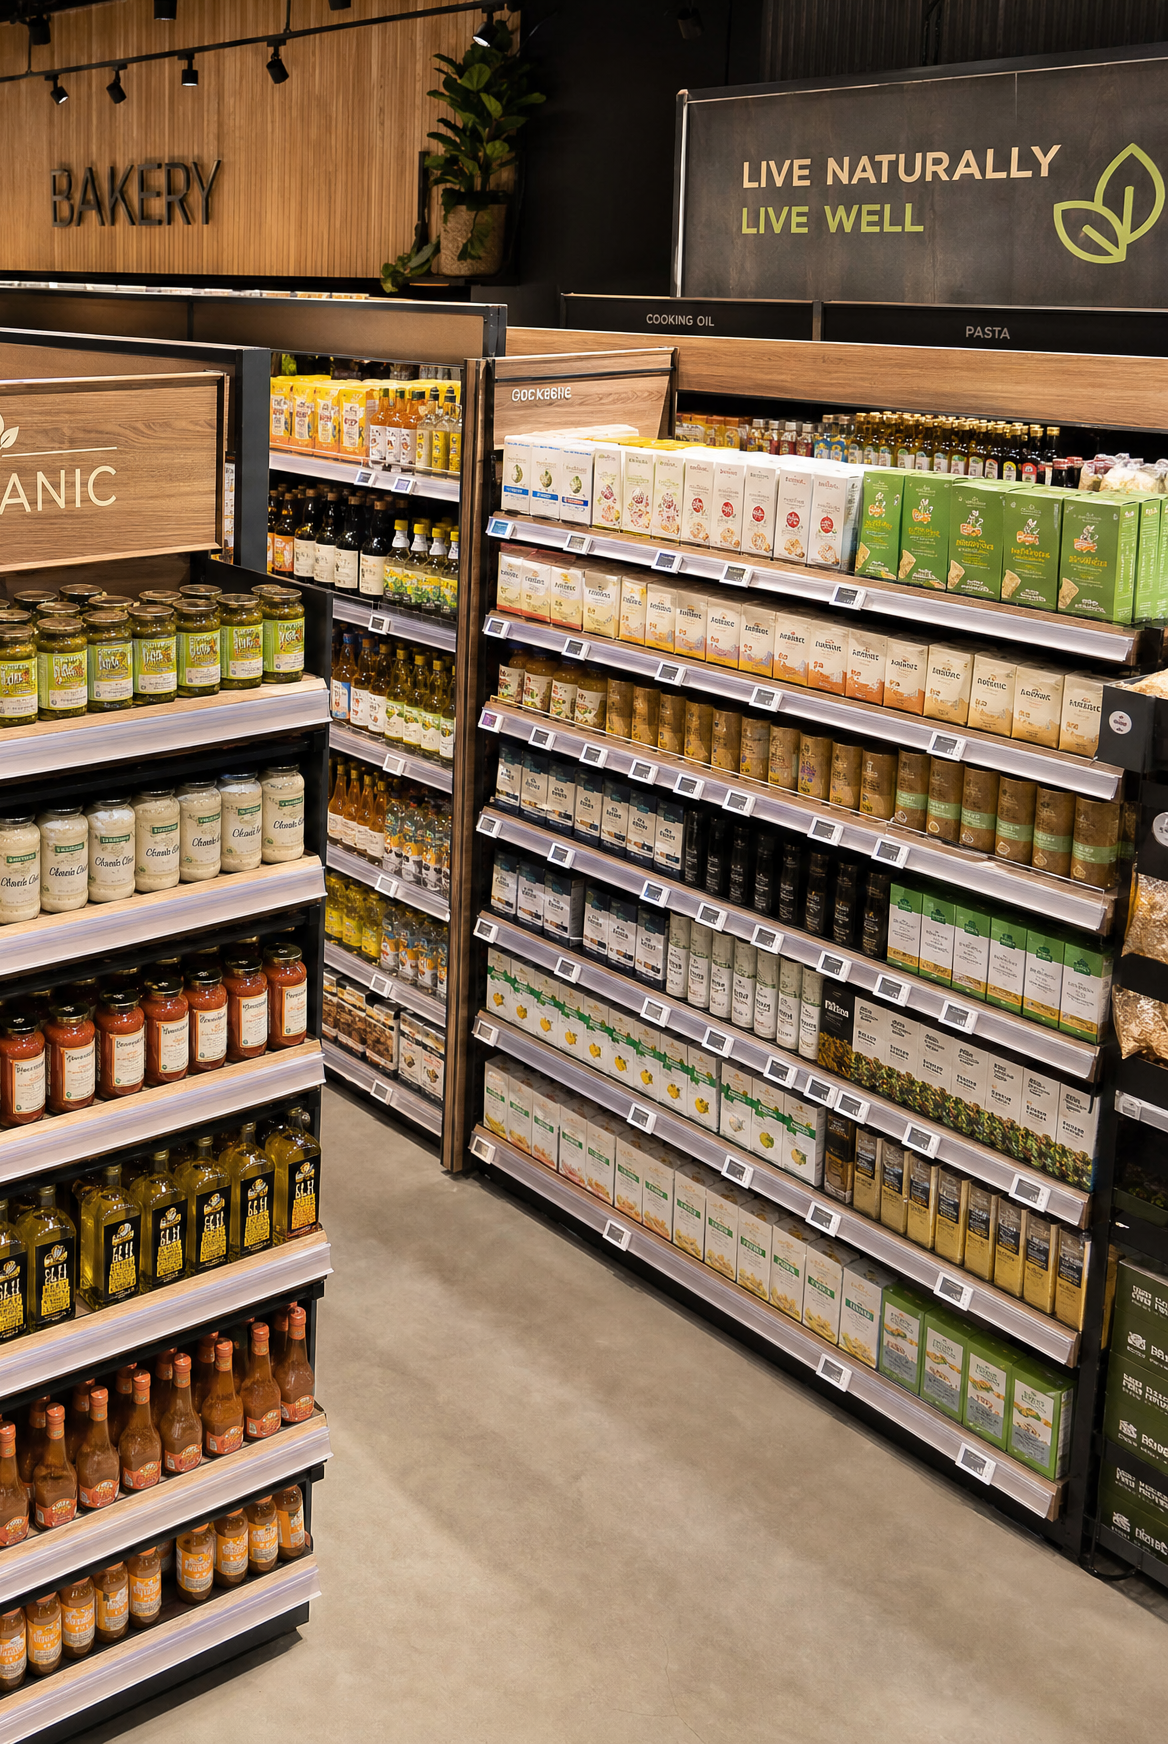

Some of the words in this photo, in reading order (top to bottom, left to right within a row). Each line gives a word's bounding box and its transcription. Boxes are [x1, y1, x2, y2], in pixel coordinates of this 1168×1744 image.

[743, 159, 811, 188] LIVE
[827, 144, 1062, 186] NATURALLY
[50, 160, 222, 227] BAKERY
[742, 206, 809, 234] LIVE
[824, 203, 924, 233] WELL
[646, 313, 693, 326] COOKING
[697, 315, 715, 327] OIL
[965, 325, 1010, 340] PASTA
